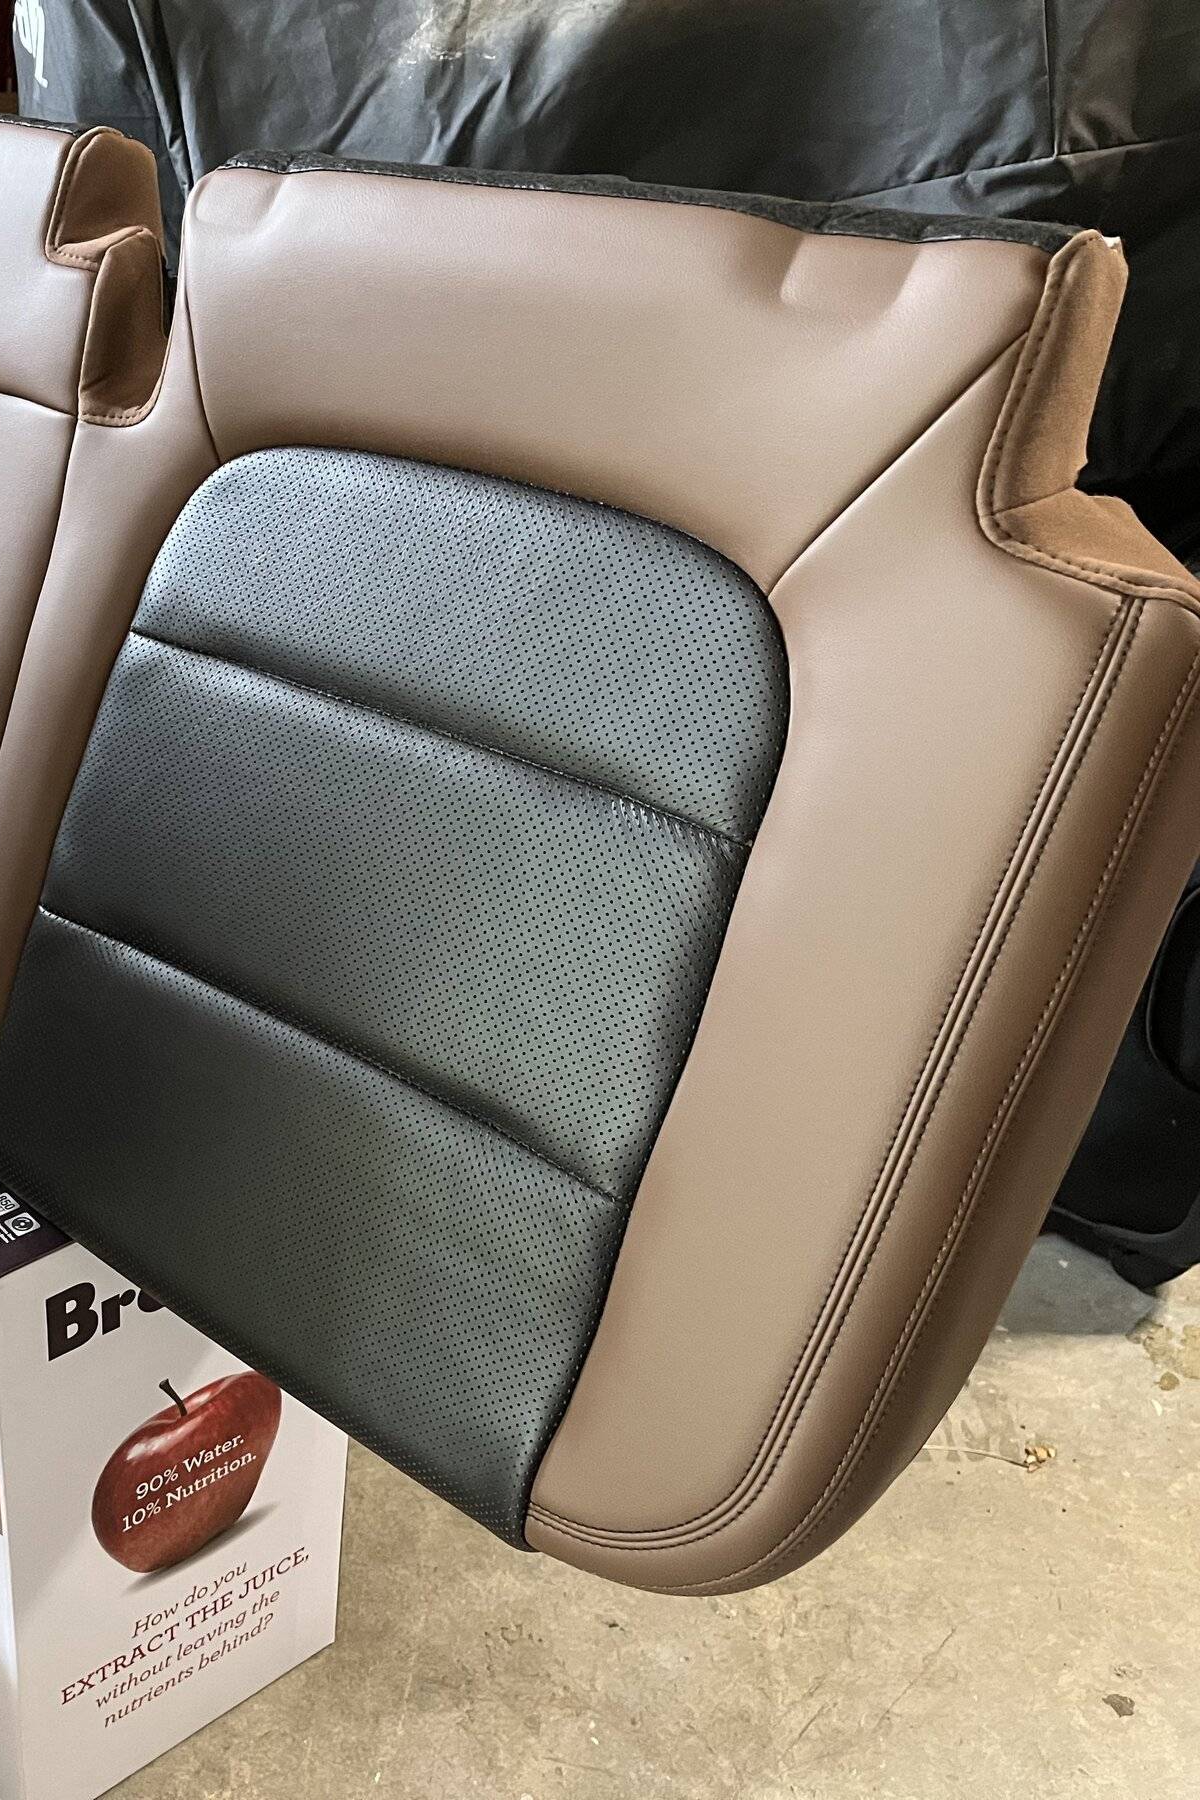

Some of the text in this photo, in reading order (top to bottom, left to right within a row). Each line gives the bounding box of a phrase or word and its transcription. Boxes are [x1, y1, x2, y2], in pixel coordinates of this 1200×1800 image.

[122, 1452, 257, 1533] 10% Nutrition.
[135, 1434, 245, 1501] 90% Water.
[61, 1547, 309, 1706] EXTRACT THE JUICE,
[131, 1562, 248, 1639] How do you
[95, 1590, 280, 1710] without leaving the
[104, 1612, 274, 1728] nutrients behind?
